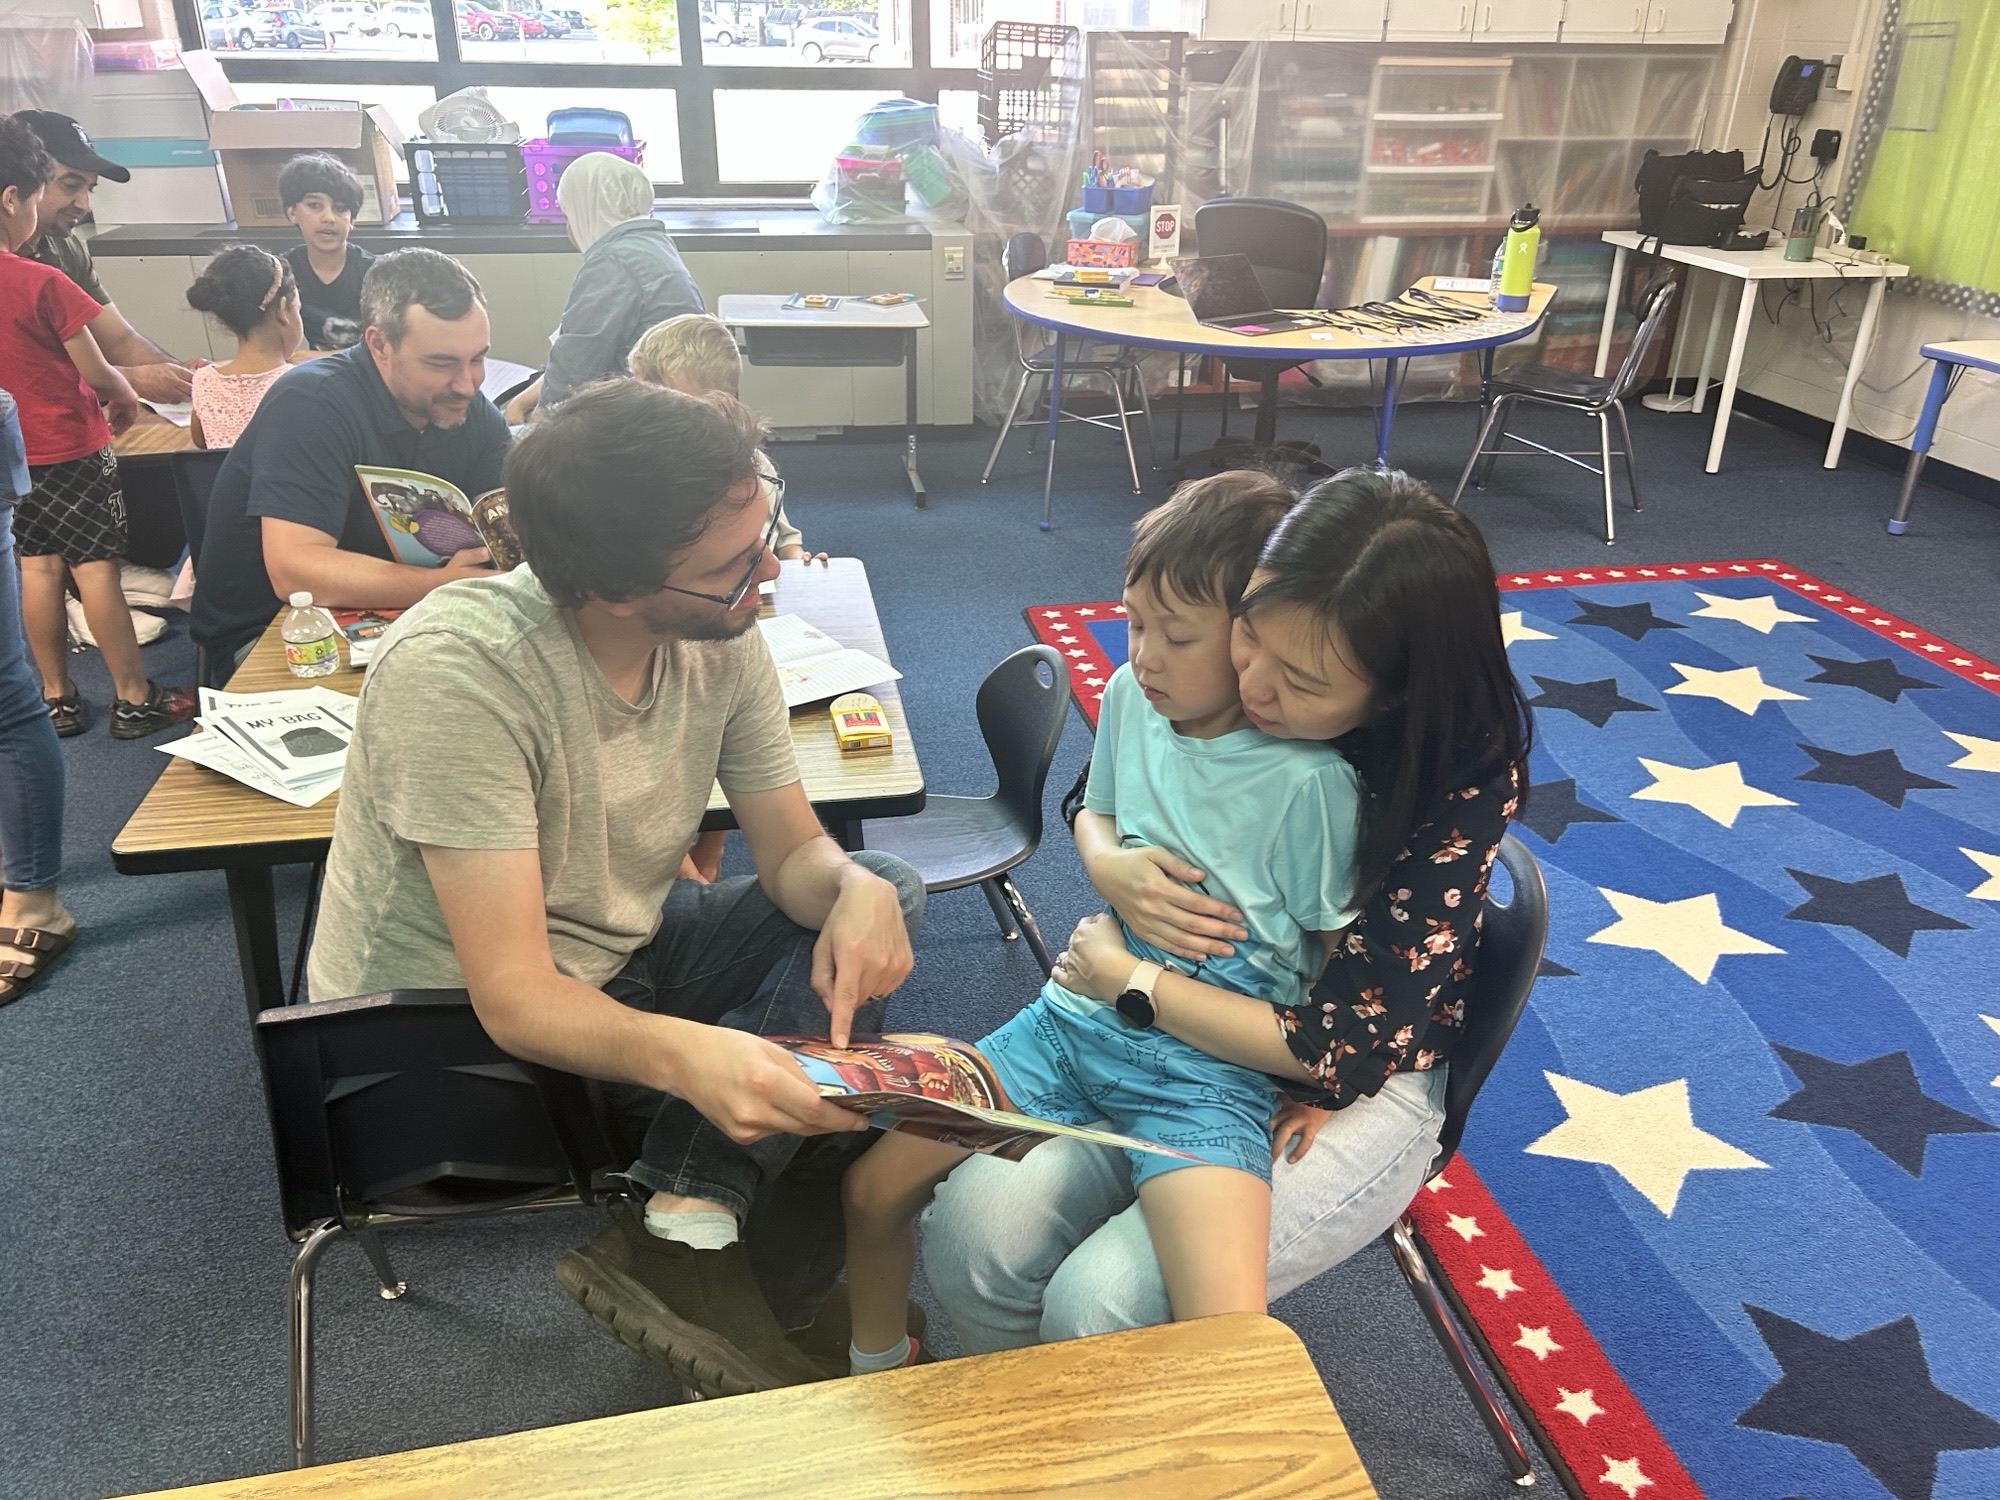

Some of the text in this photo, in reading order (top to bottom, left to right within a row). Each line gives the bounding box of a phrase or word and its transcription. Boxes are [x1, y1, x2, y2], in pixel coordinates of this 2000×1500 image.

[1156, 220, 1175, 232] STOP
[245, 712, 322, 729] MY BAG
